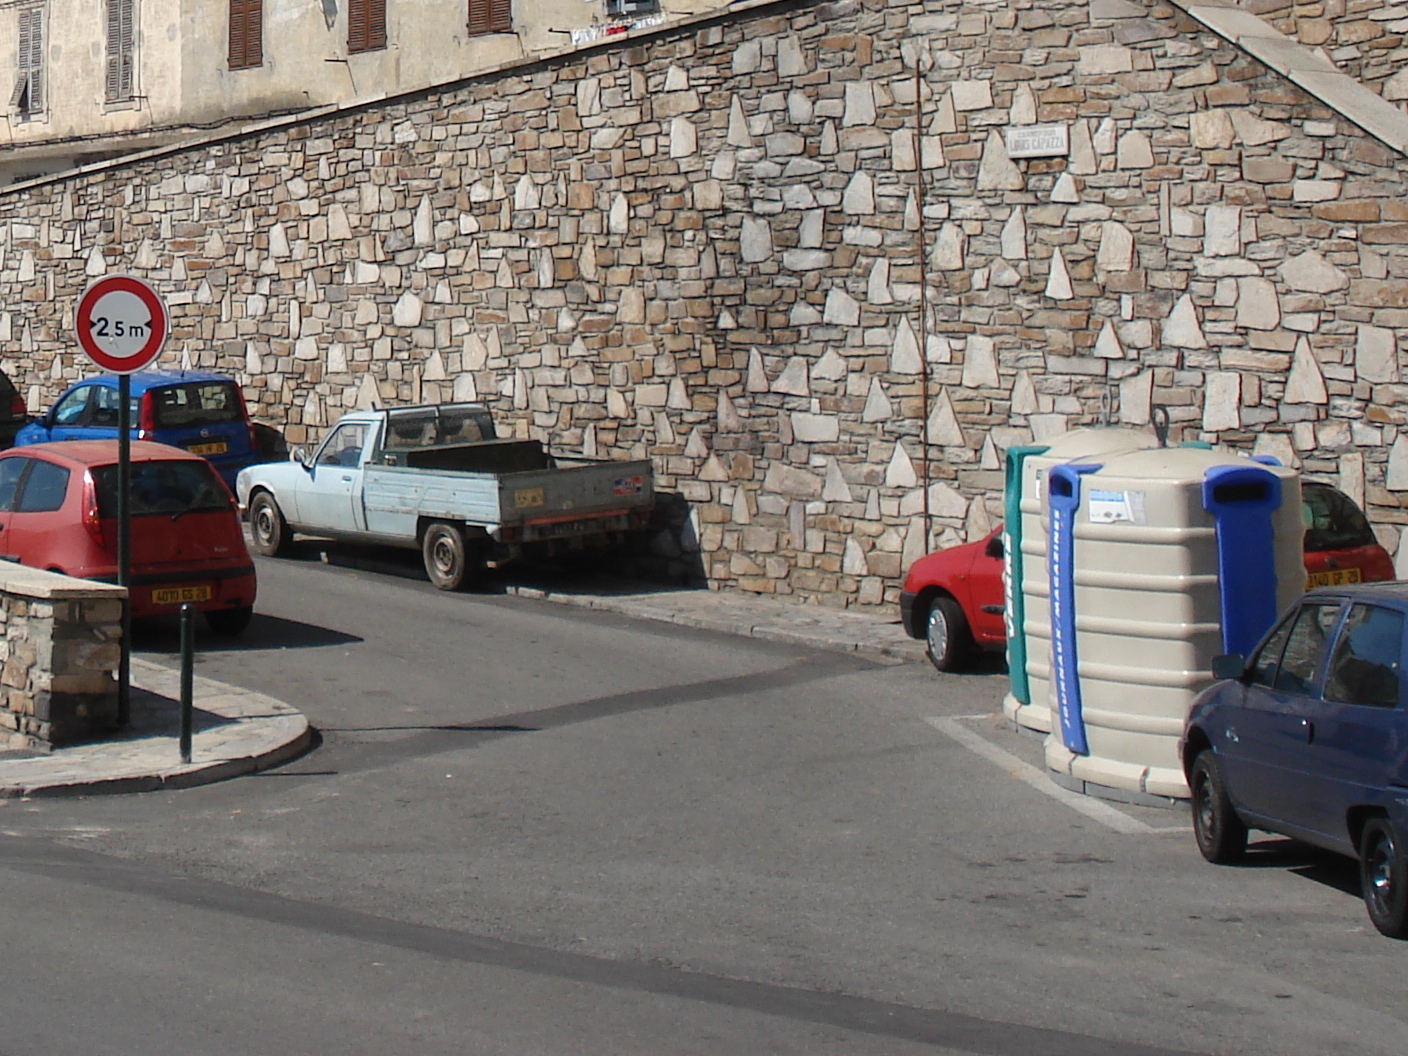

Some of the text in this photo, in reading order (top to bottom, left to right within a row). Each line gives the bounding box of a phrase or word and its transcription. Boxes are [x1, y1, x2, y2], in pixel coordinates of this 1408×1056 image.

[1009, 136, 1064, 151] LOUIS CAPAZZA
[129, 325, 144, 337] m
